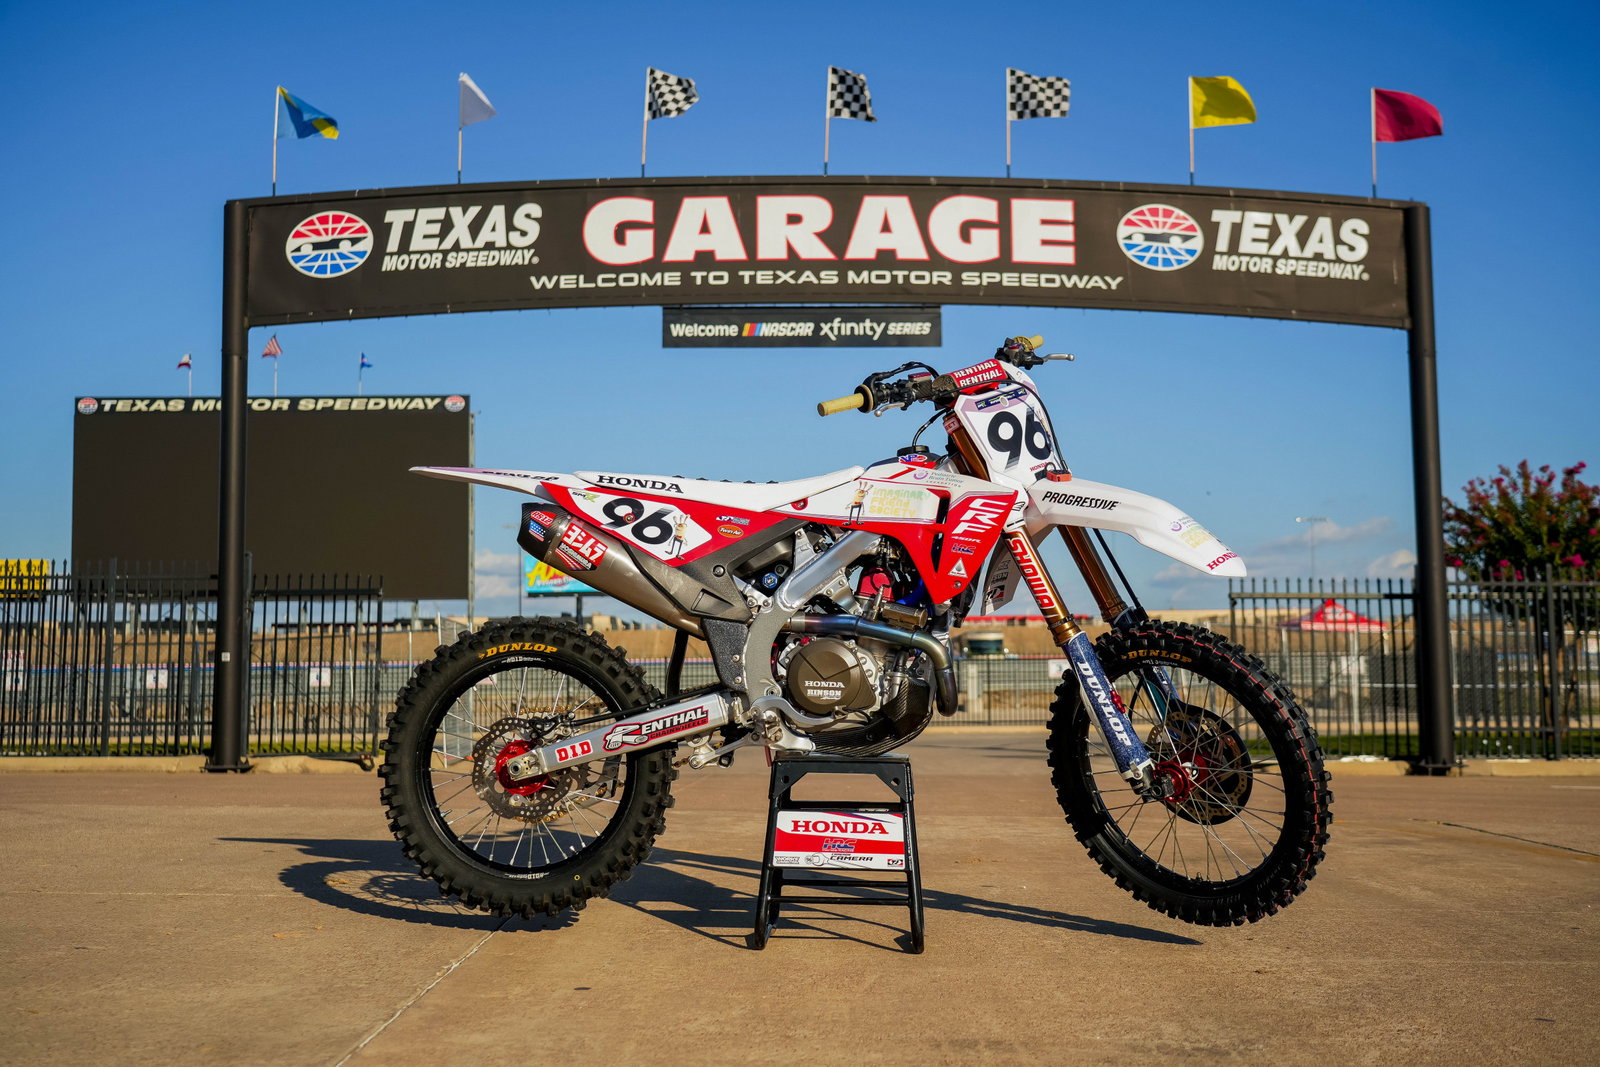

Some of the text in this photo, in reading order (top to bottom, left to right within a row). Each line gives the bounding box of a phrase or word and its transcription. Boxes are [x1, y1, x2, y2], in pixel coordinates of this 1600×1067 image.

[384, 202, 543, 253] TEXAS
[582, 195, 1076, 266] GARAGE
[1211, 209, 1370, 262] TEXAS
[381, 252, 443, 272] MOTOR
[1212, 254, 1273, 273] MOTOR
[530, 270, 1124, 290] WELCOME TO TEXAS MOTOR SPEEDWAY
[670, 317, 931, 341] Welcome NASCAR xfinity SERIES
[959, 368, 1003, 388] RENTHAL
[101, 397, 442, 412] TEXAS MOR SPEEDWAY
[987, 406, 1052, 473] 96
[597, 475, 684, 494] HONDA
[1042, 491, 1118, 511] PROGRESSIVE
[602, 498, 674, 545] 96
[951, 498, 1009, 534] CRF
[562, 524, 607, 561] ヨシムラ
[1006, 536, 1056, 609] SHOWA
[486, 642, 558, 658] DUNLOP
[1127, 649, 1193, 663] DUNLOP
[804, 680, 846, 689] HONDA
[1076, 661, 1132, 746] DUNLOP
[650, 718, 708, 739] CHAINWHEELS
[557, 740, 592, 762] D.I.D
[791, 820, 889, 834] HONDA
[823, 838, 857, 849] HRC
